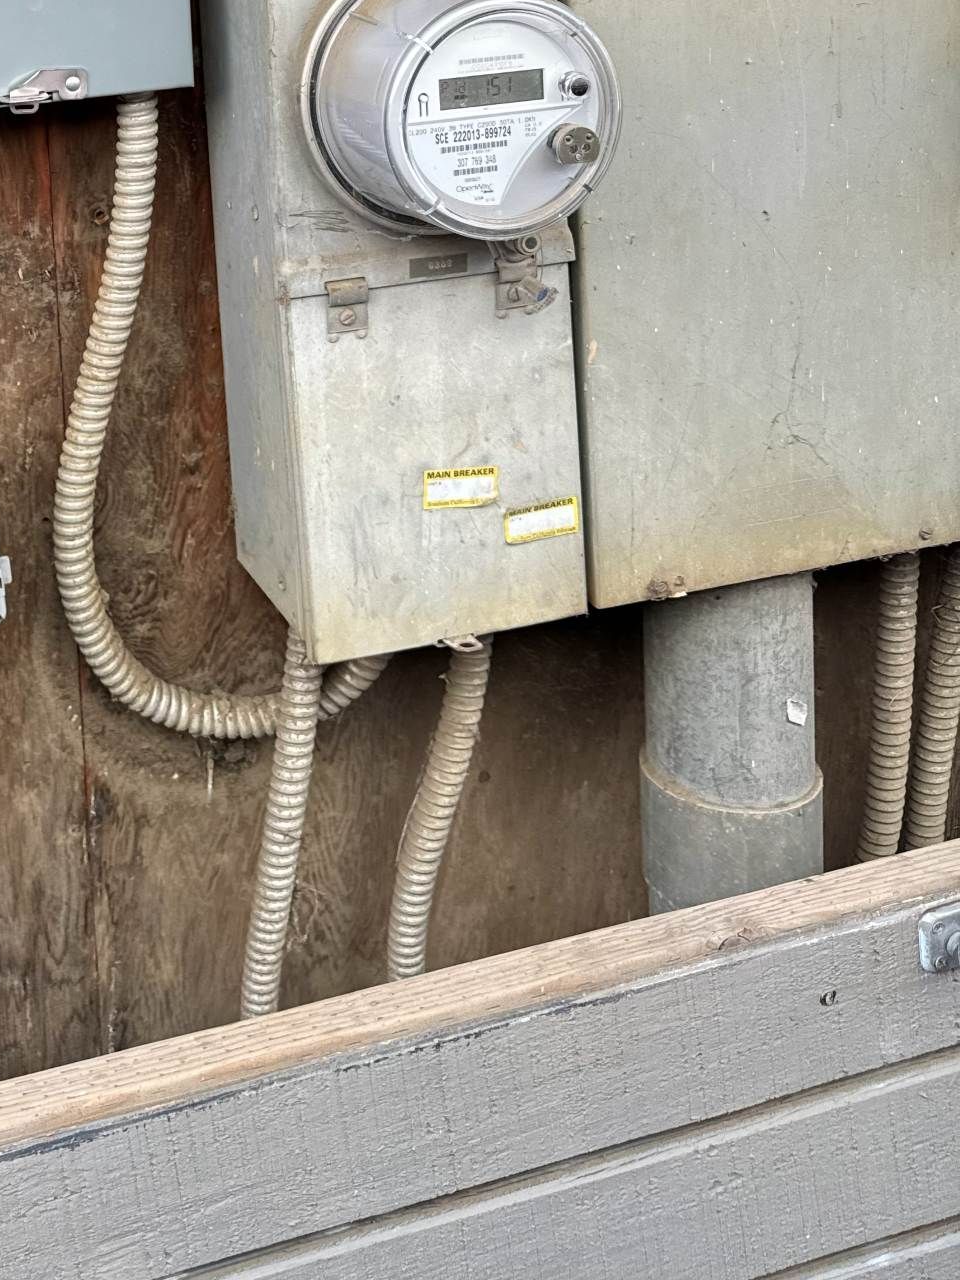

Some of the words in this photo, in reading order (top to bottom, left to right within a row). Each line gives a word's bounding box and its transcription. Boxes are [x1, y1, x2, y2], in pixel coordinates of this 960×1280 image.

[434, 132, 449, 145] SCE
[453, 125, 512, 143] 222013-899724
[426, 470, 452, 480] MAIN
[453, 467, 495, 478] BREAKER
[508, 506, 533, 517] MAIN
[533, 497, 574, 513] BREAKER
